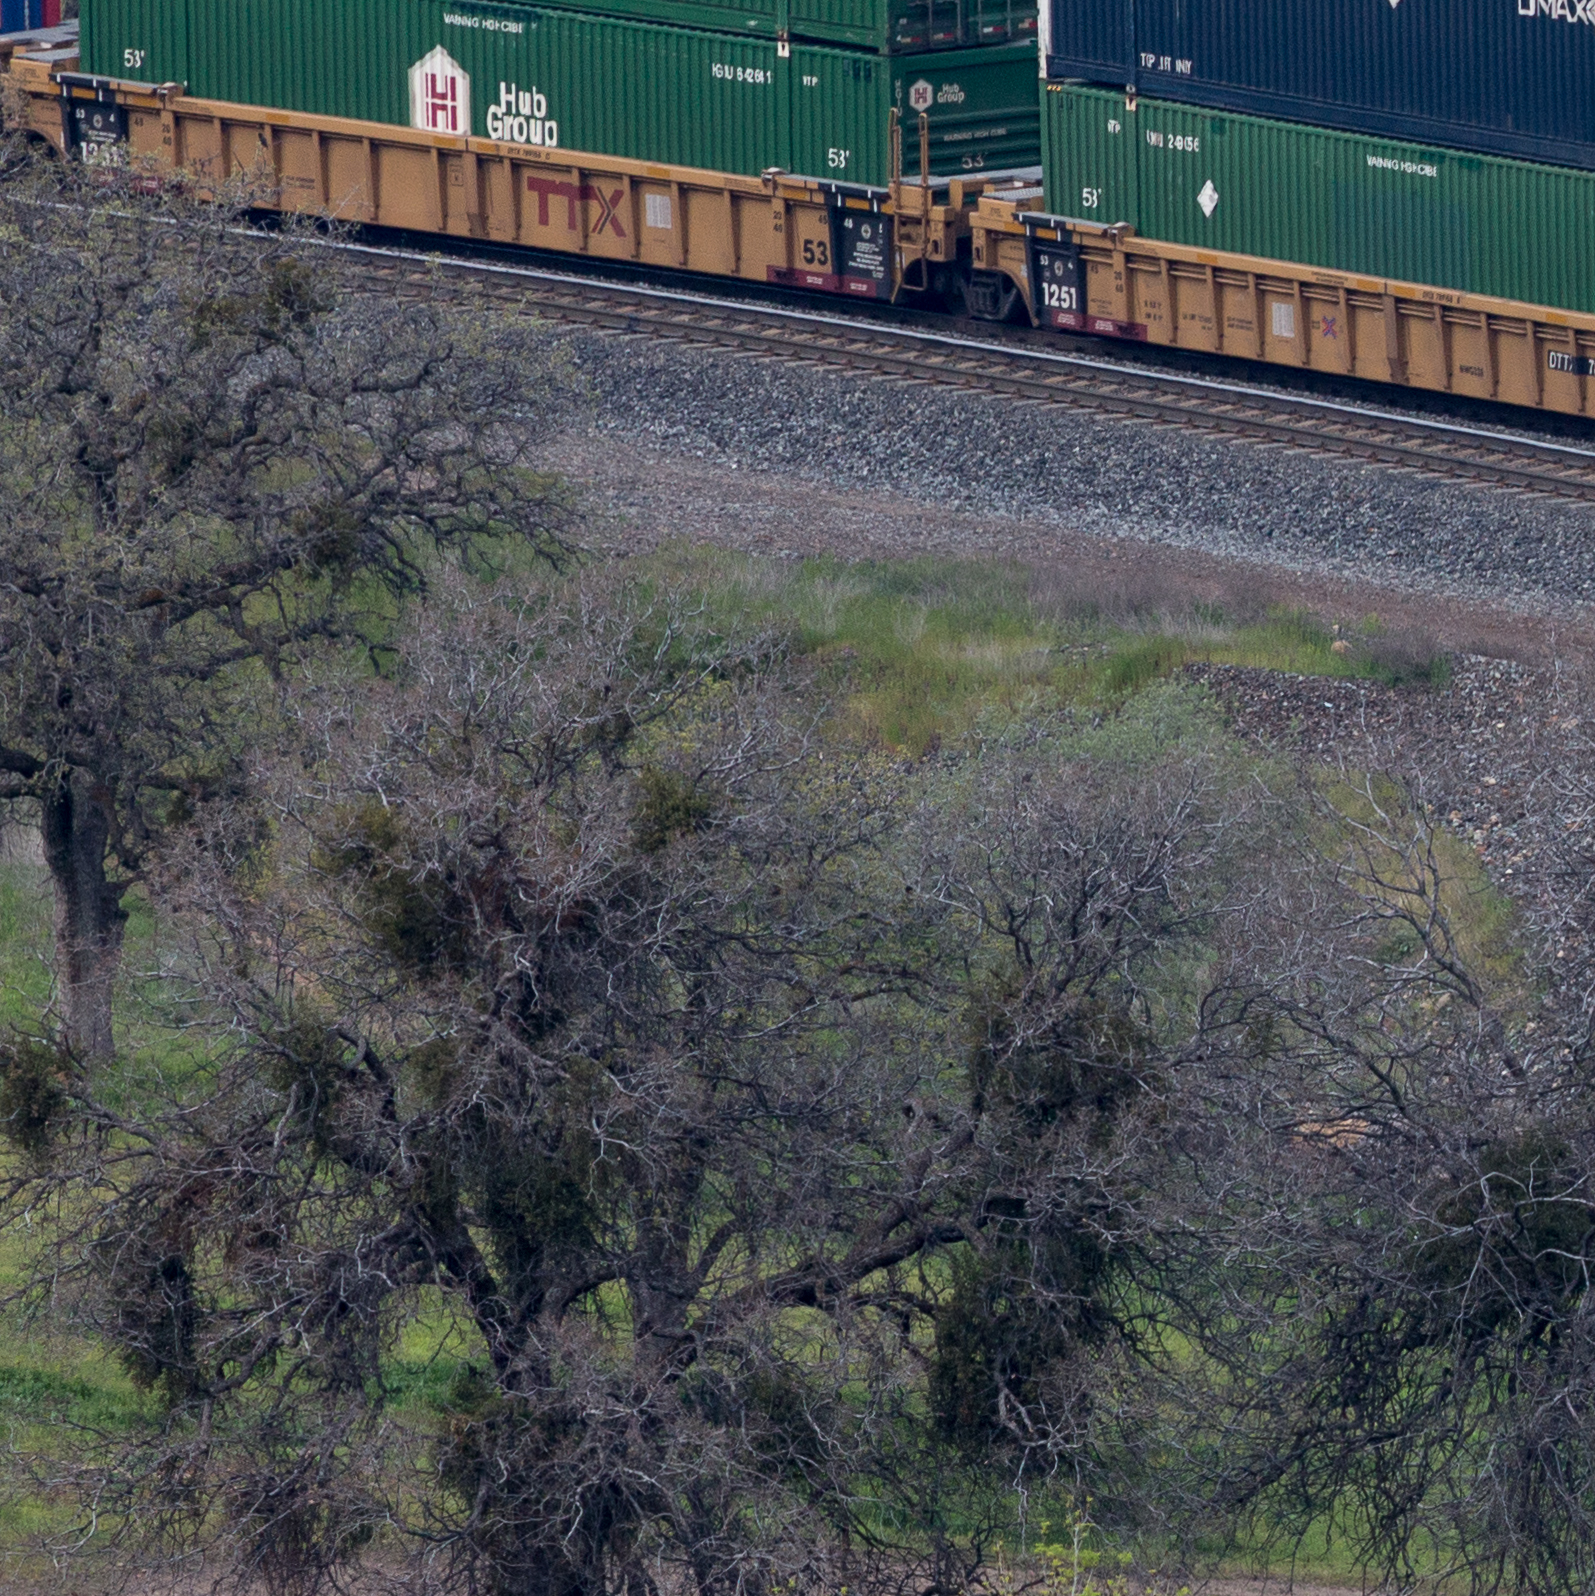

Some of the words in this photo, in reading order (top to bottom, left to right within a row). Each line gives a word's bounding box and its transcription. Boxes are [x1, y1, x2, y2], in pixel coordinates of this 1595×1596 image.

[500, 82, 547, 119] Hub
[487, 105, 557, 147] Group
[527, 176, 627, 238] TTX
[803, 239, 829, 266] 53
[1043, 282, 1077, 310] 1251
